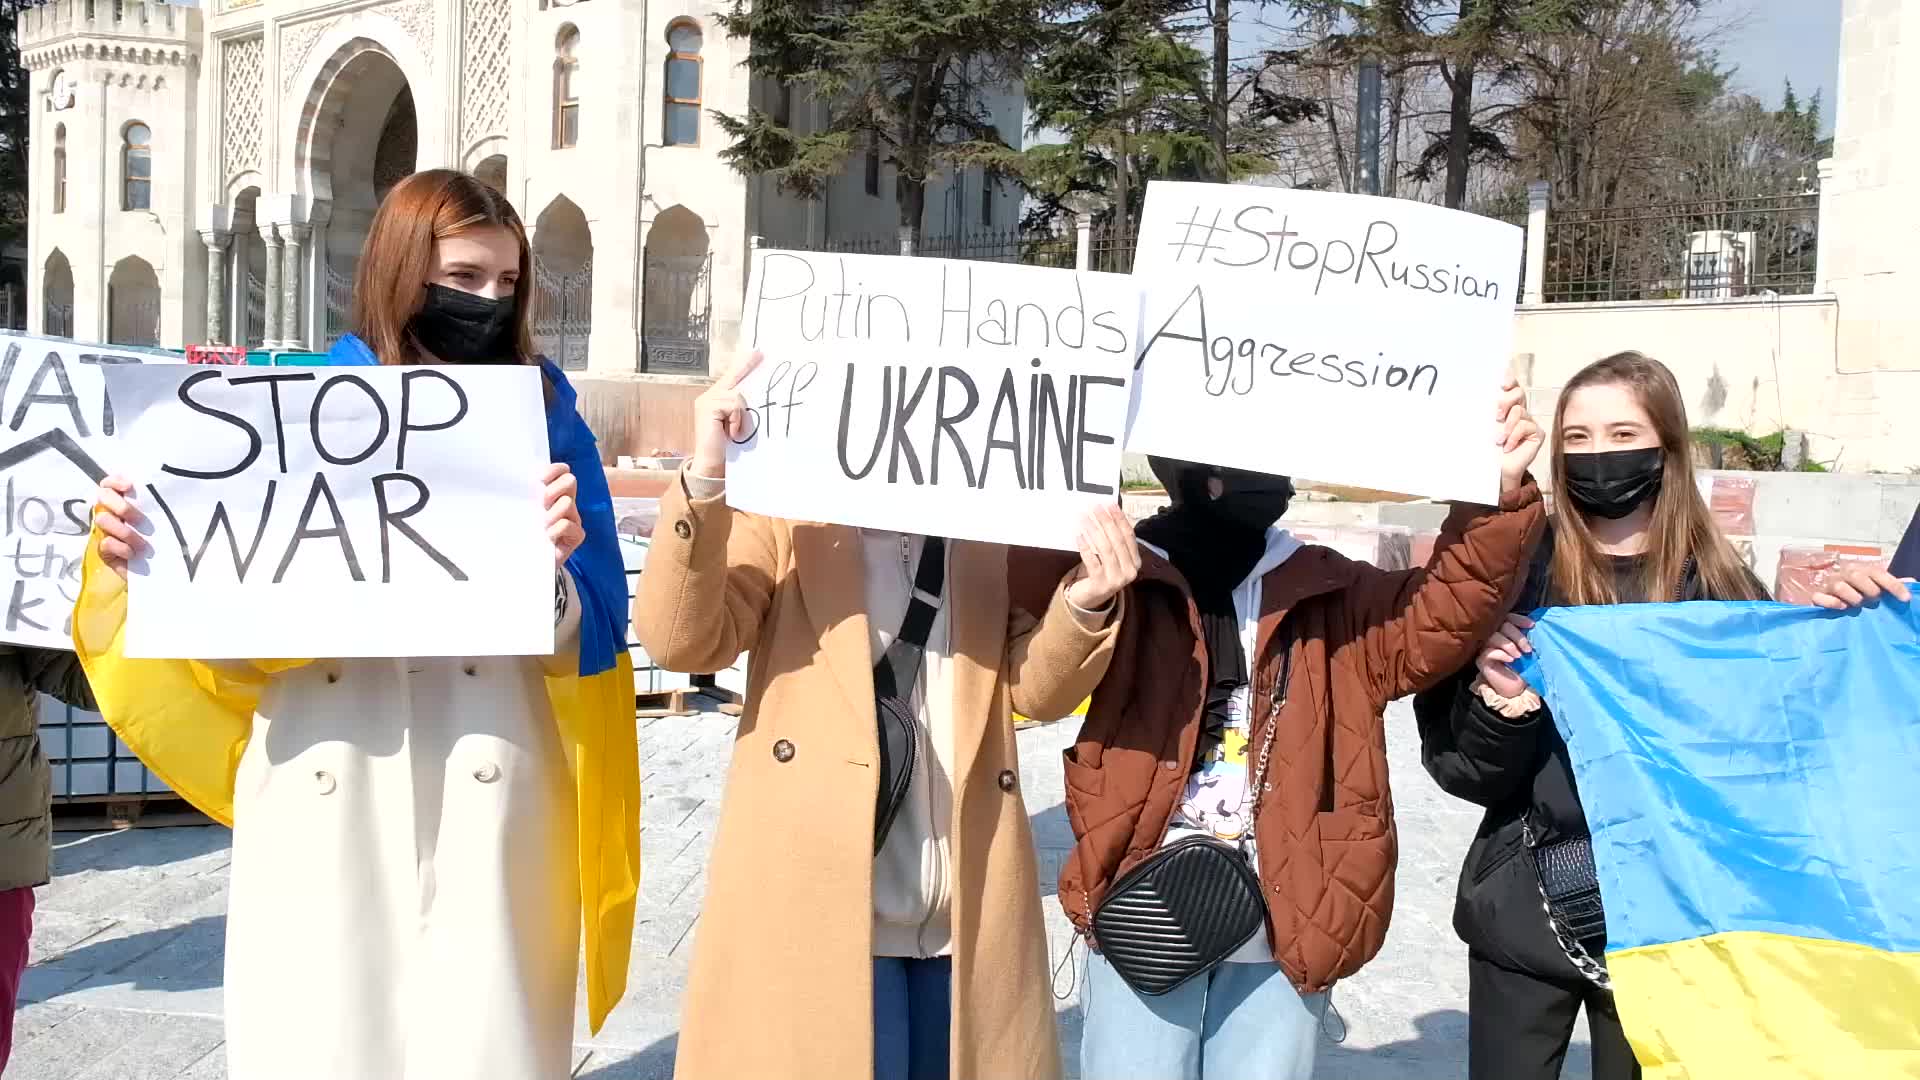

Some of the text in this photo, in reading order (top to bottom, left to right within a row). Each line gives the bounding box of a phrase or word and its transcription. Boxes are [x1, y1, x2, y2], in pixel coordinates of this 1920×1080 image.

[753, 253, 1127, 353] Putin Hands
[1168, 205, 1499, 300] #StopRussian
[1134, 284, 1439, 396] Aggression
[161, 369, 469, 480] STOP
[146, 472, 469, 583] WAR
